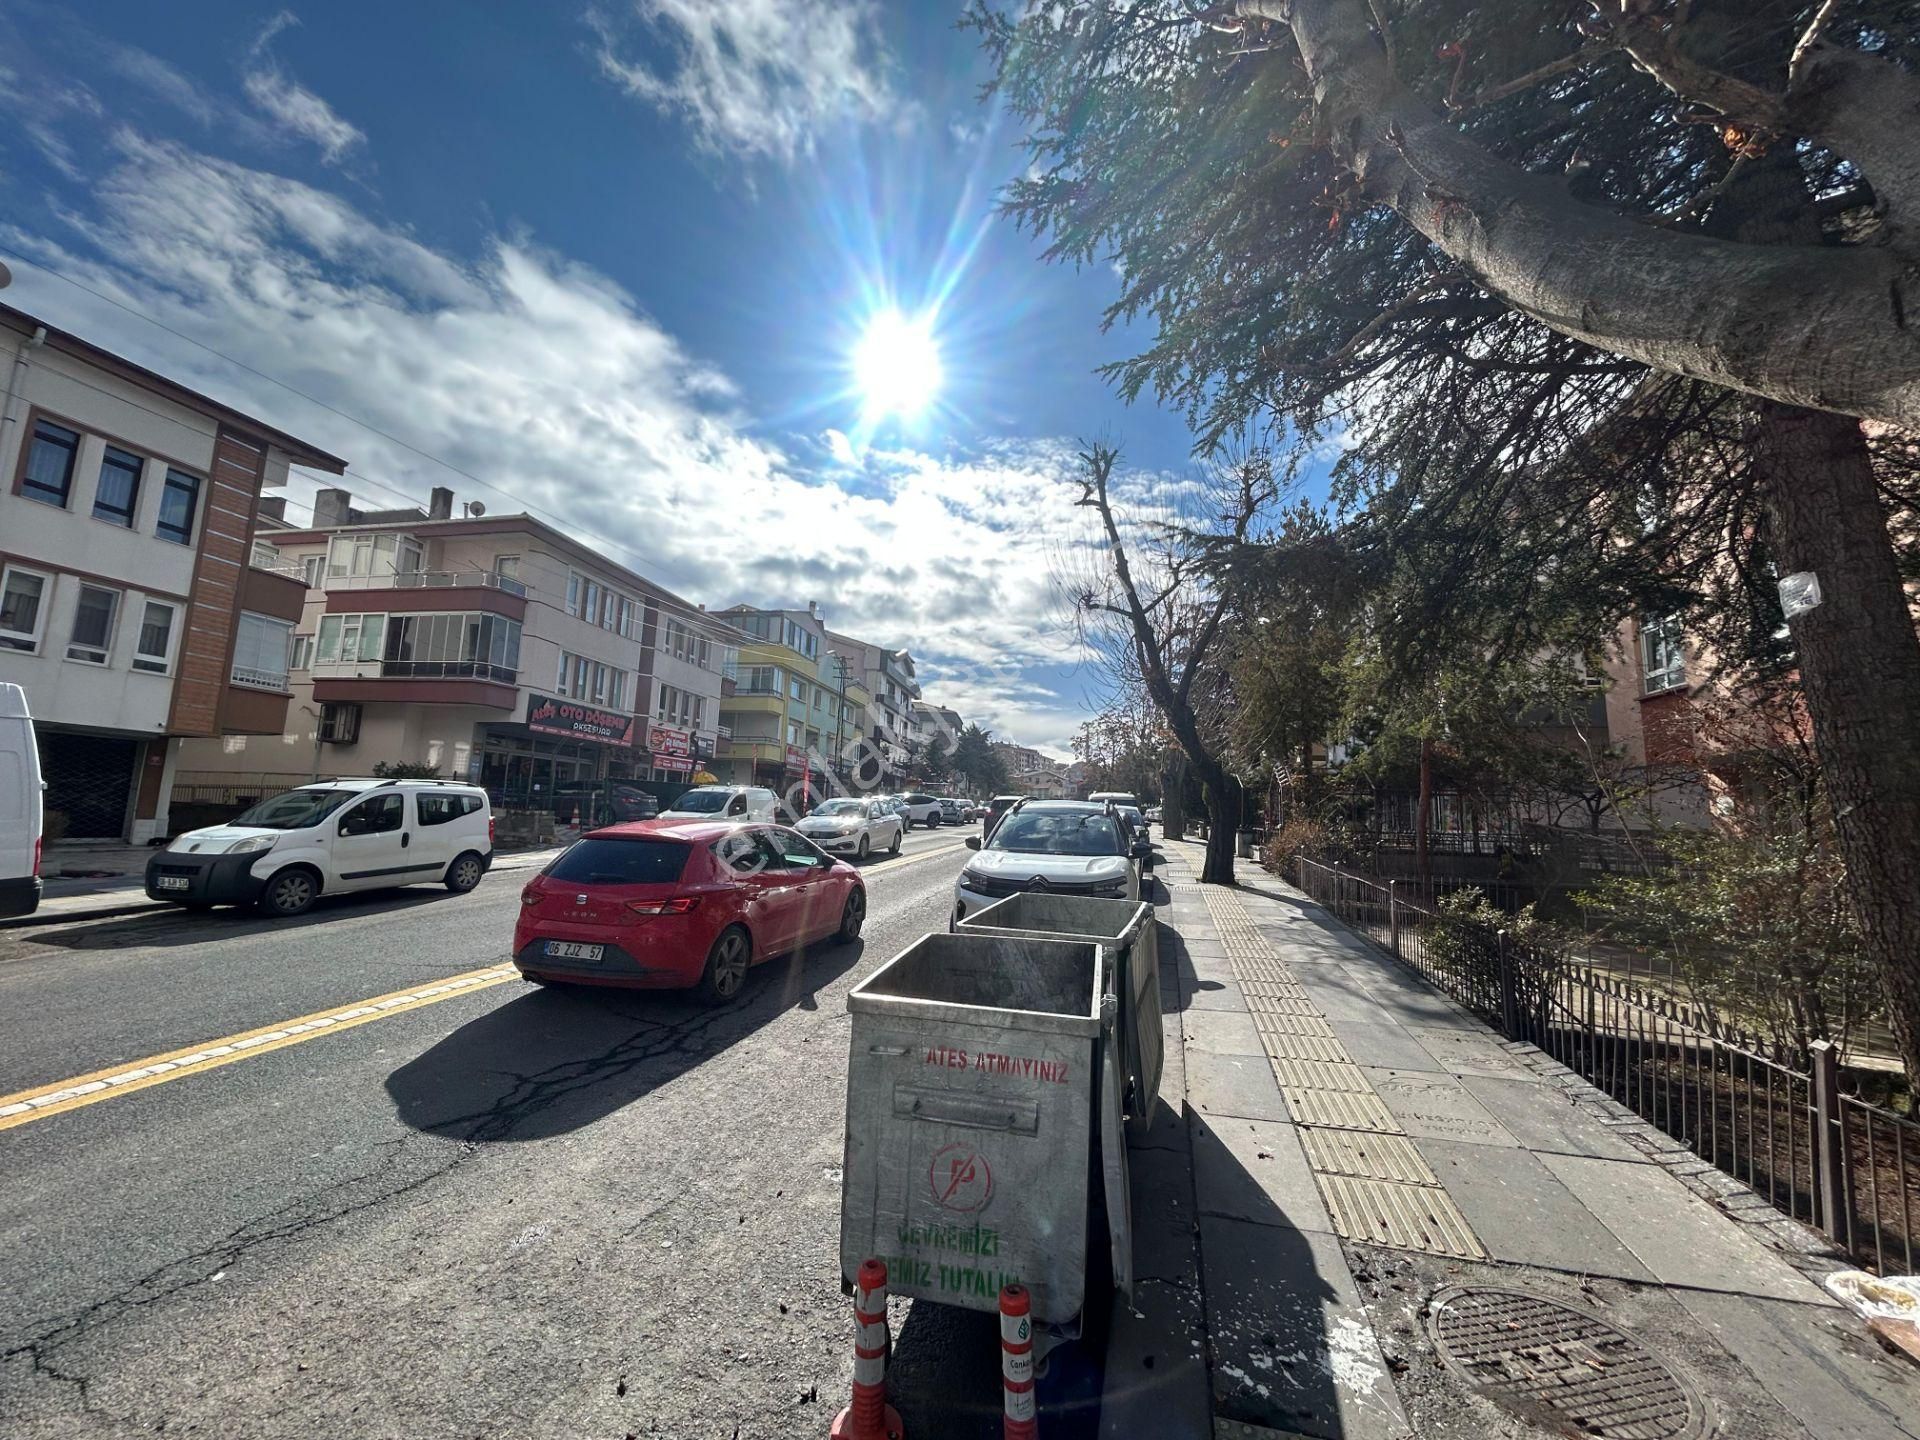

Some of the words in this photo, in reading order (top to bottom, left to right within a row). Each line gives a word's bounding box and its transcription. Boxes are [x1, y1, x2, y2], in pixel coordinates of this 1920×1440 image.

[559, 705, 583, 721] OTO
[548, 942, 561, 954] 06
[564, 944, 583, 957] ZJZ
[589, 946, 602, 959] 57
[974, 1052, 1069, 1084] ATMAYINIZ
